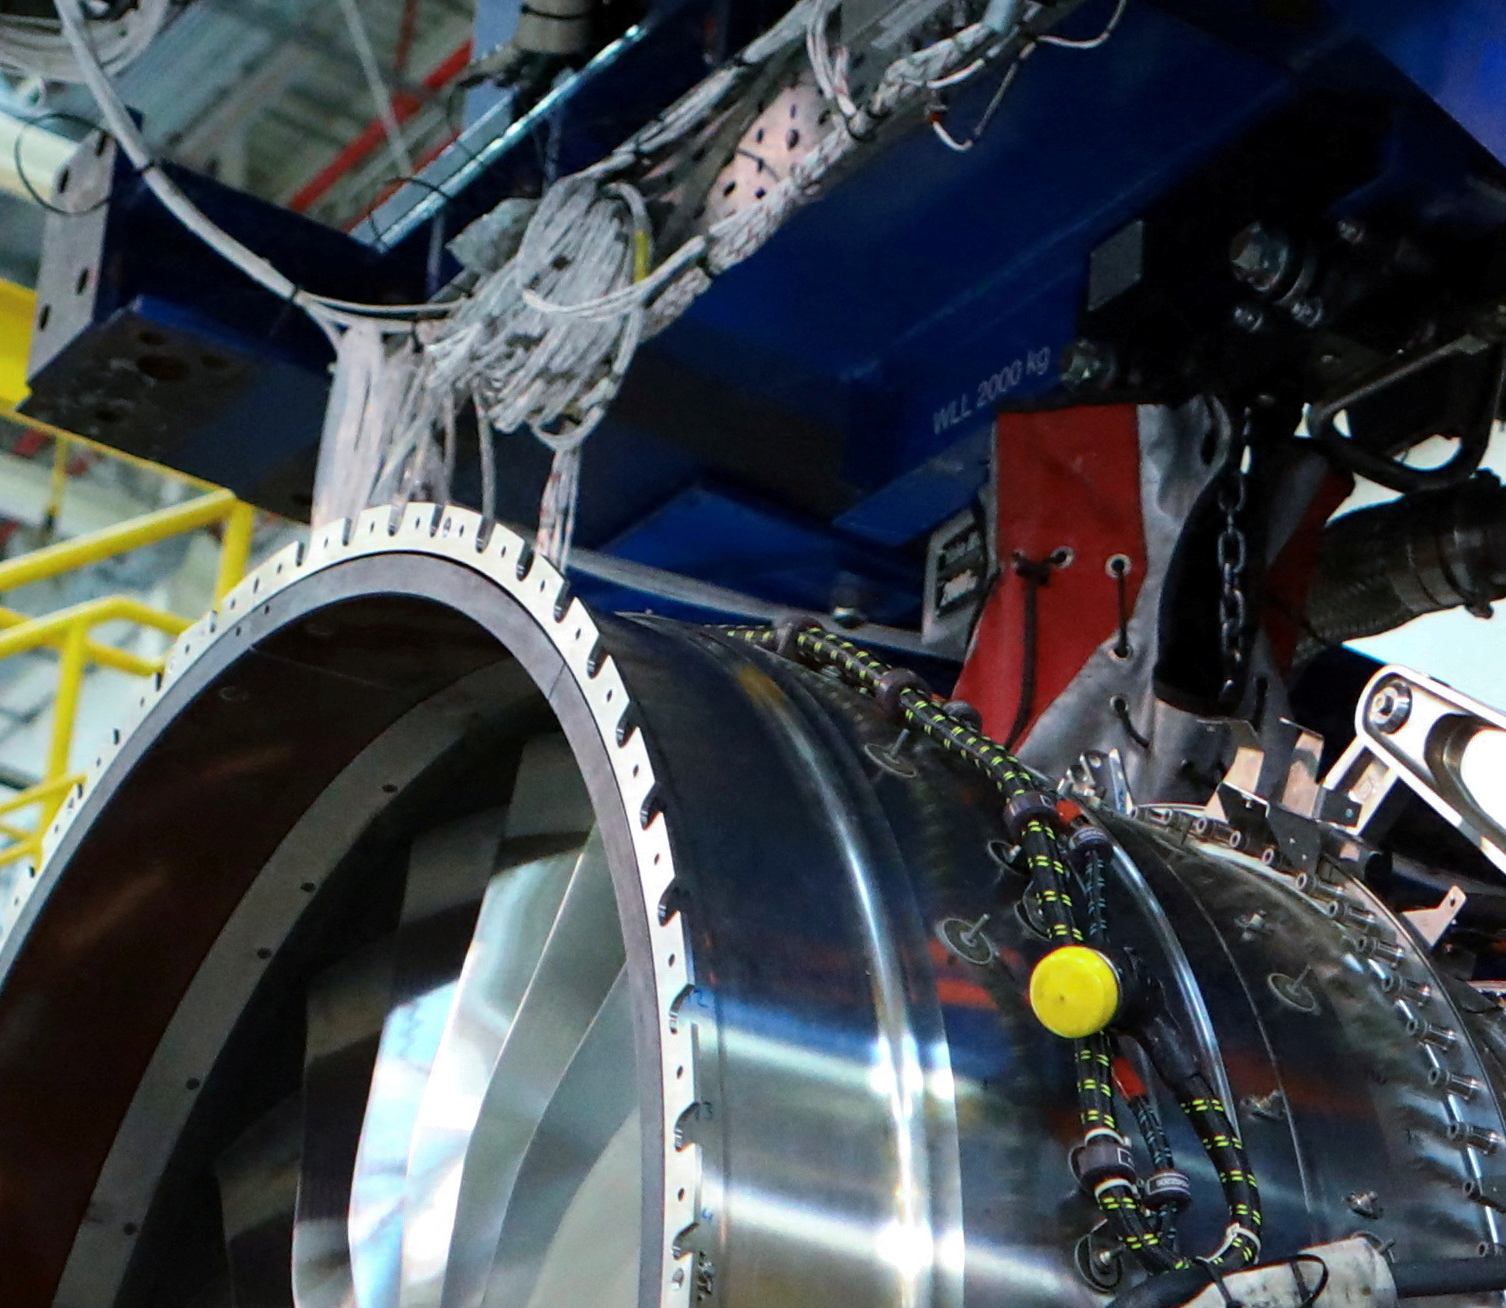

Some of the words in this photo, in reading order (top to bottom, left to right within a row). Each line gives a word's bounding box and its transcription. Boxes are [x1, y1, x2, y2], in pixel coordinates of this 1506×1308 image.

[933, 393, 972, 435] WLL
[977, 359, 1022, 408] 2000
[1025, 346, 1051, 377] kg
